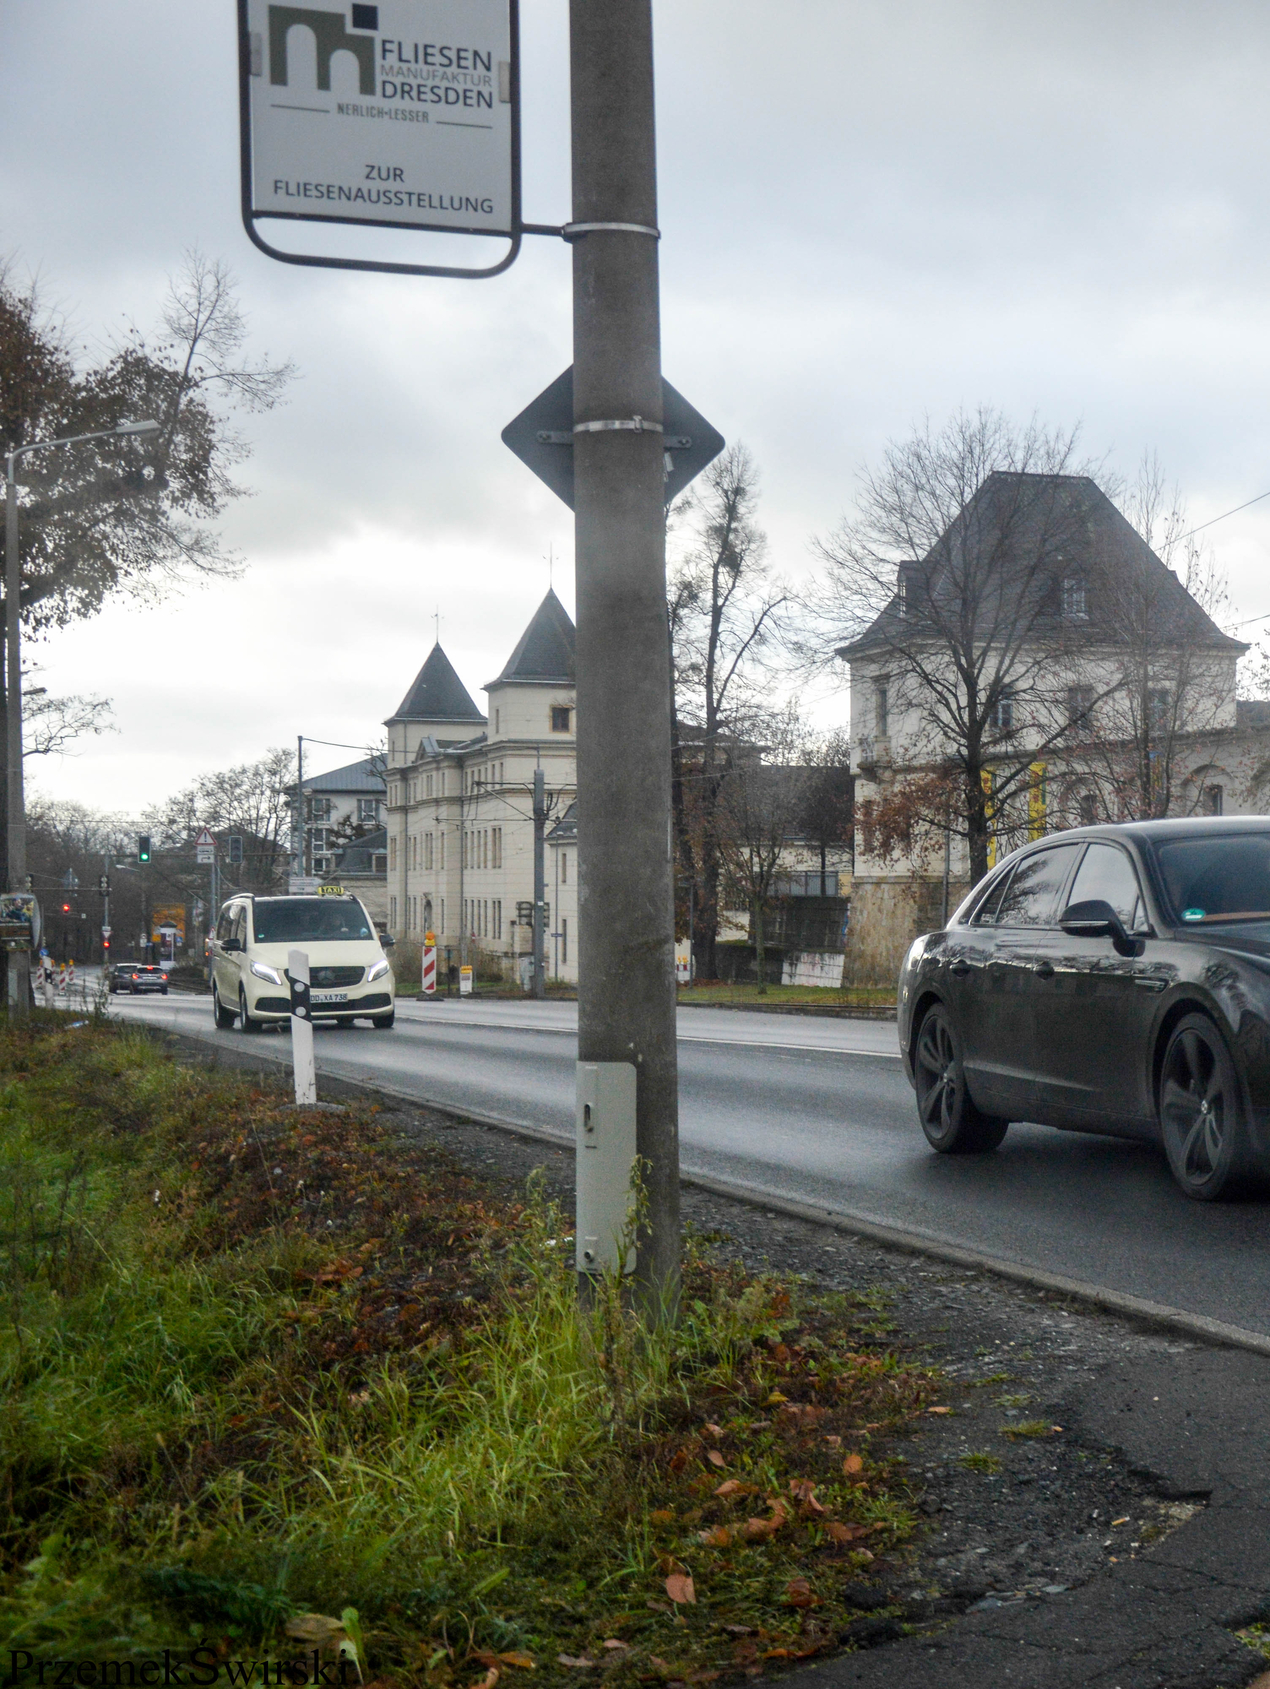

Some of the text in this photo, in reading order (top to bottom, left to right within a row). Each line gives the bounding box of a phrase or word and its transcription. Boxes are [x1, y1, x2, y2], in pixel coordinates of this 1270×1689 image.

[381, 39, 492, 72] FLIESEN
[380, 64, 493, 88] MANUFAKTUR
[381, 80, 493, 109] DRESDEN
[365, 164, 405, 183] ZUR
[273, 179, 494, 214] FLIESENAUSSTELLUNG
